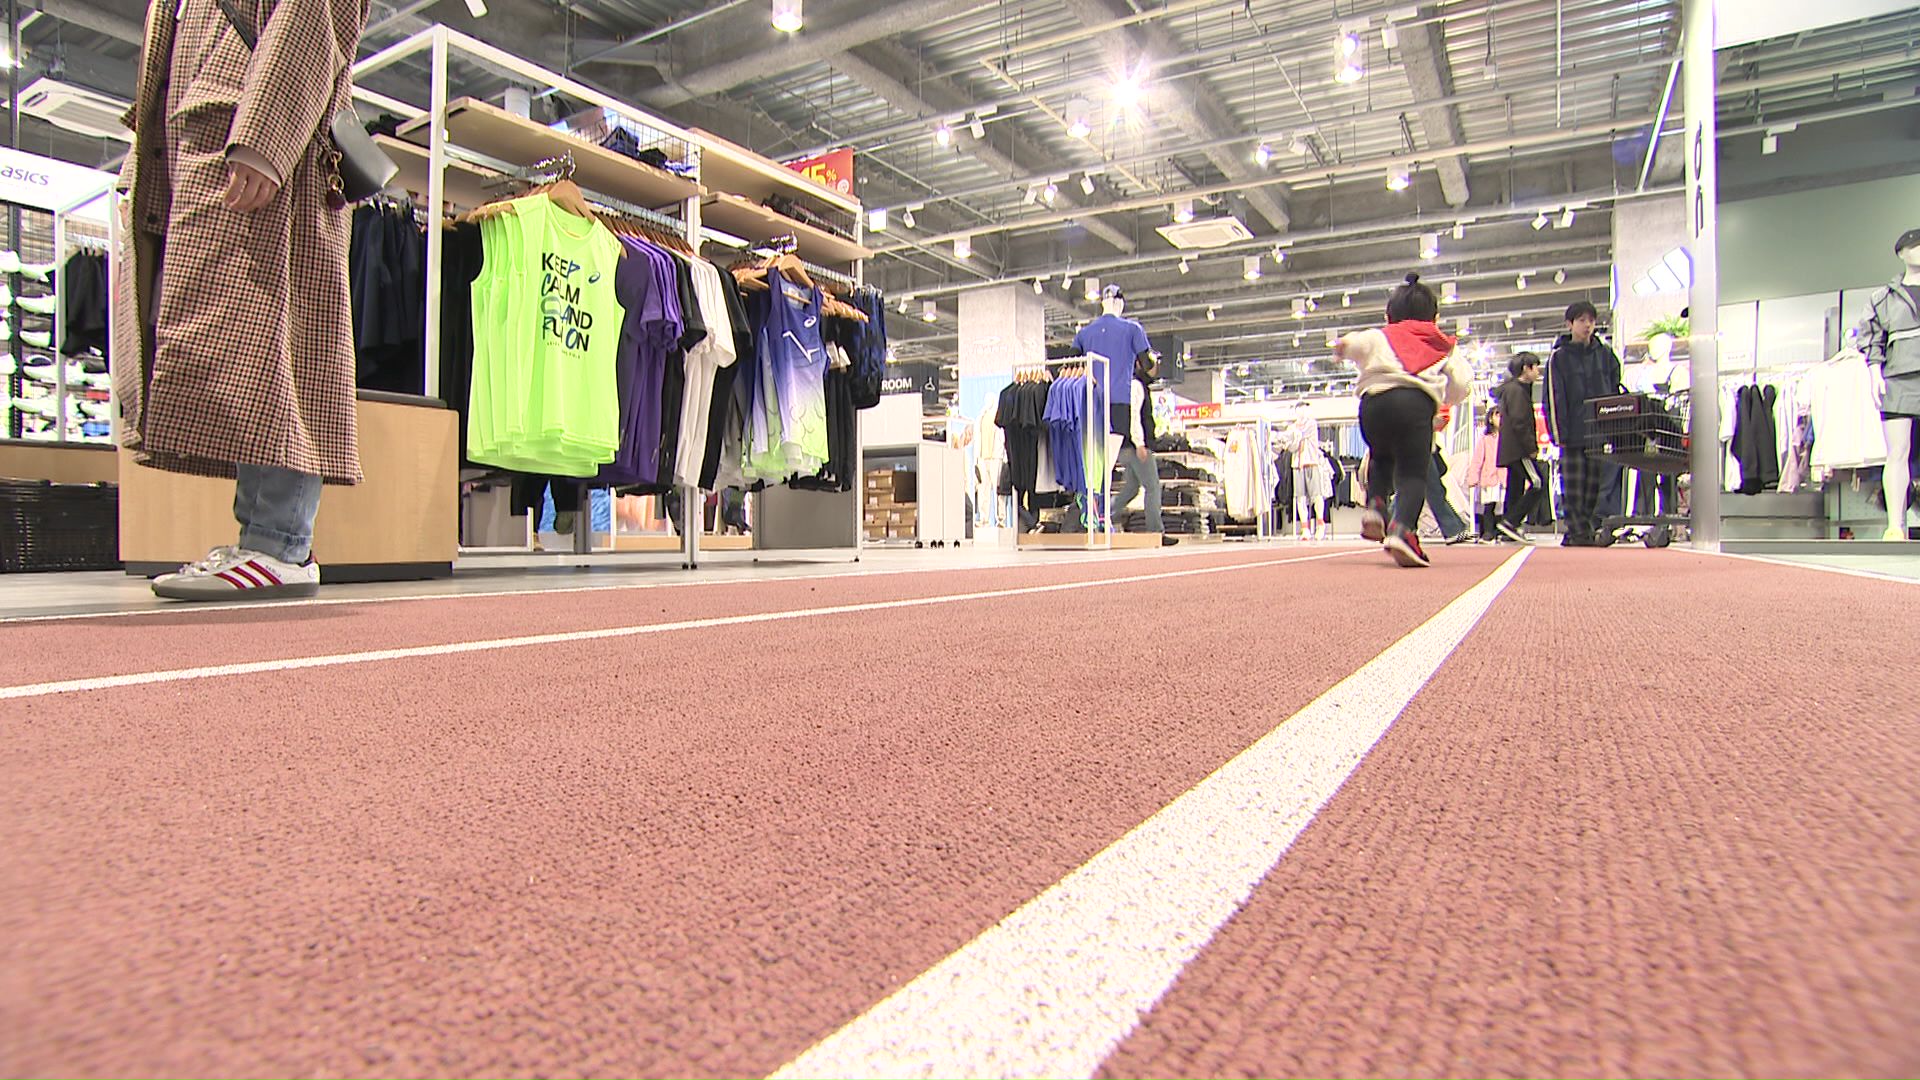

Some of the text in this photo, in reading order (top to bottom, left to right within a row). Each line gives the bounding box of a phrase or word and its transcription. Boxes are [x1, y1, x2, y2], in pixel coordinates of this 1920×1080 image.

[1, 165, 49, 186] asics
[541, 252, 581, 279] KEEP
[541, 273, 581, 305] CALM
[560, 304, 593, 330] AND
[565, 328, 590, 352] ON
[881, 376, 913, 391] ROOM
